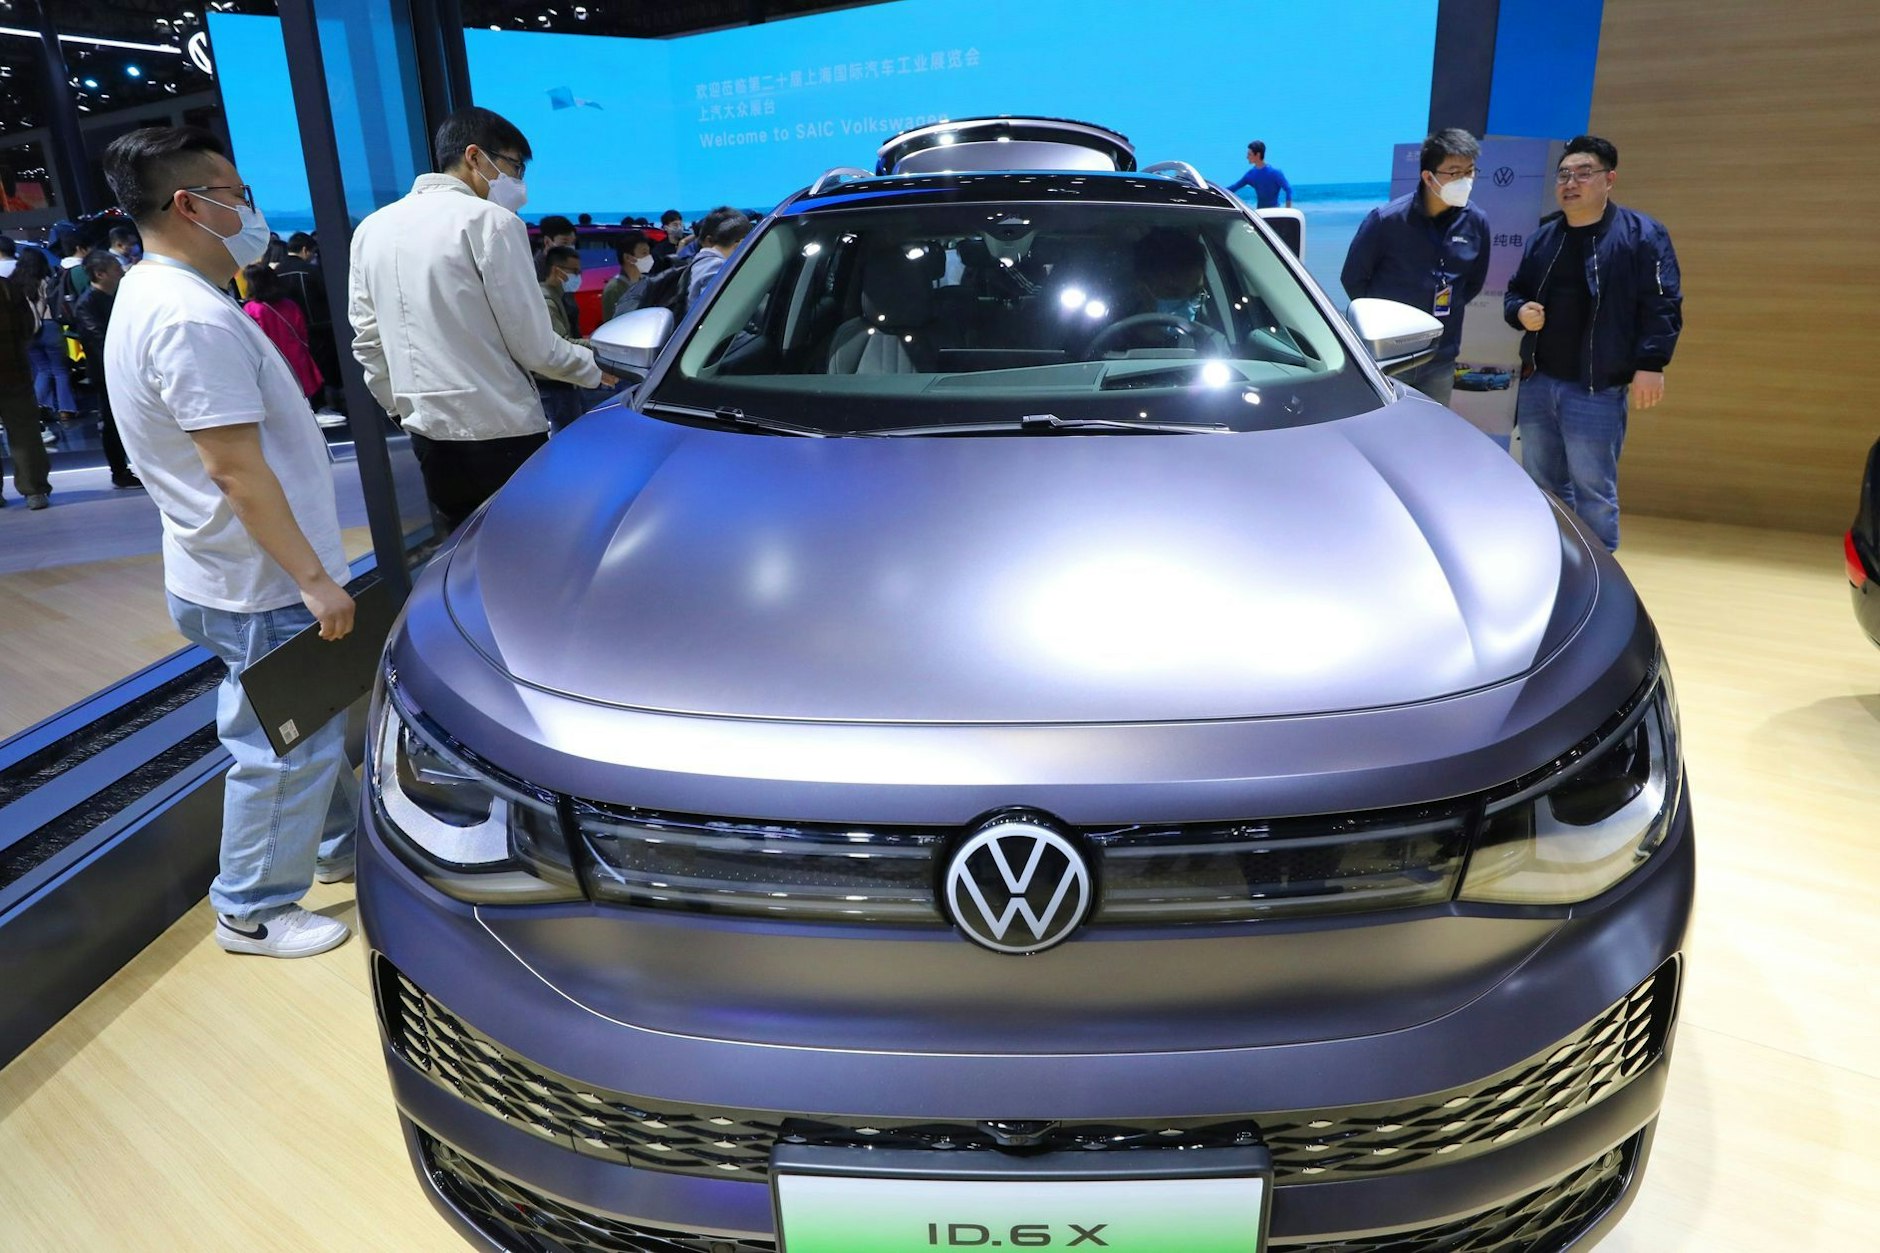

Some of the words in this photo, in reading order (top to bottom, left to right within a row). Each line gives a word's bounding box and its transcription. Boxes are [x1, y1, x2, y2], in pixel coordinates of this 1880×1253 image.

[700, 125, 768, 148] Welcome
[773, 124, 790, 141] to
[796, 120, 834, 139] SAIC
[1493, 167, 1515, 187] VW
[1493, 233, 1523, 247] 纯电
[950, 827, 1084, 949] VW
[928, 1223, 1051, 1247] ID.6
[1065, 1223, 1110, 1247] X
